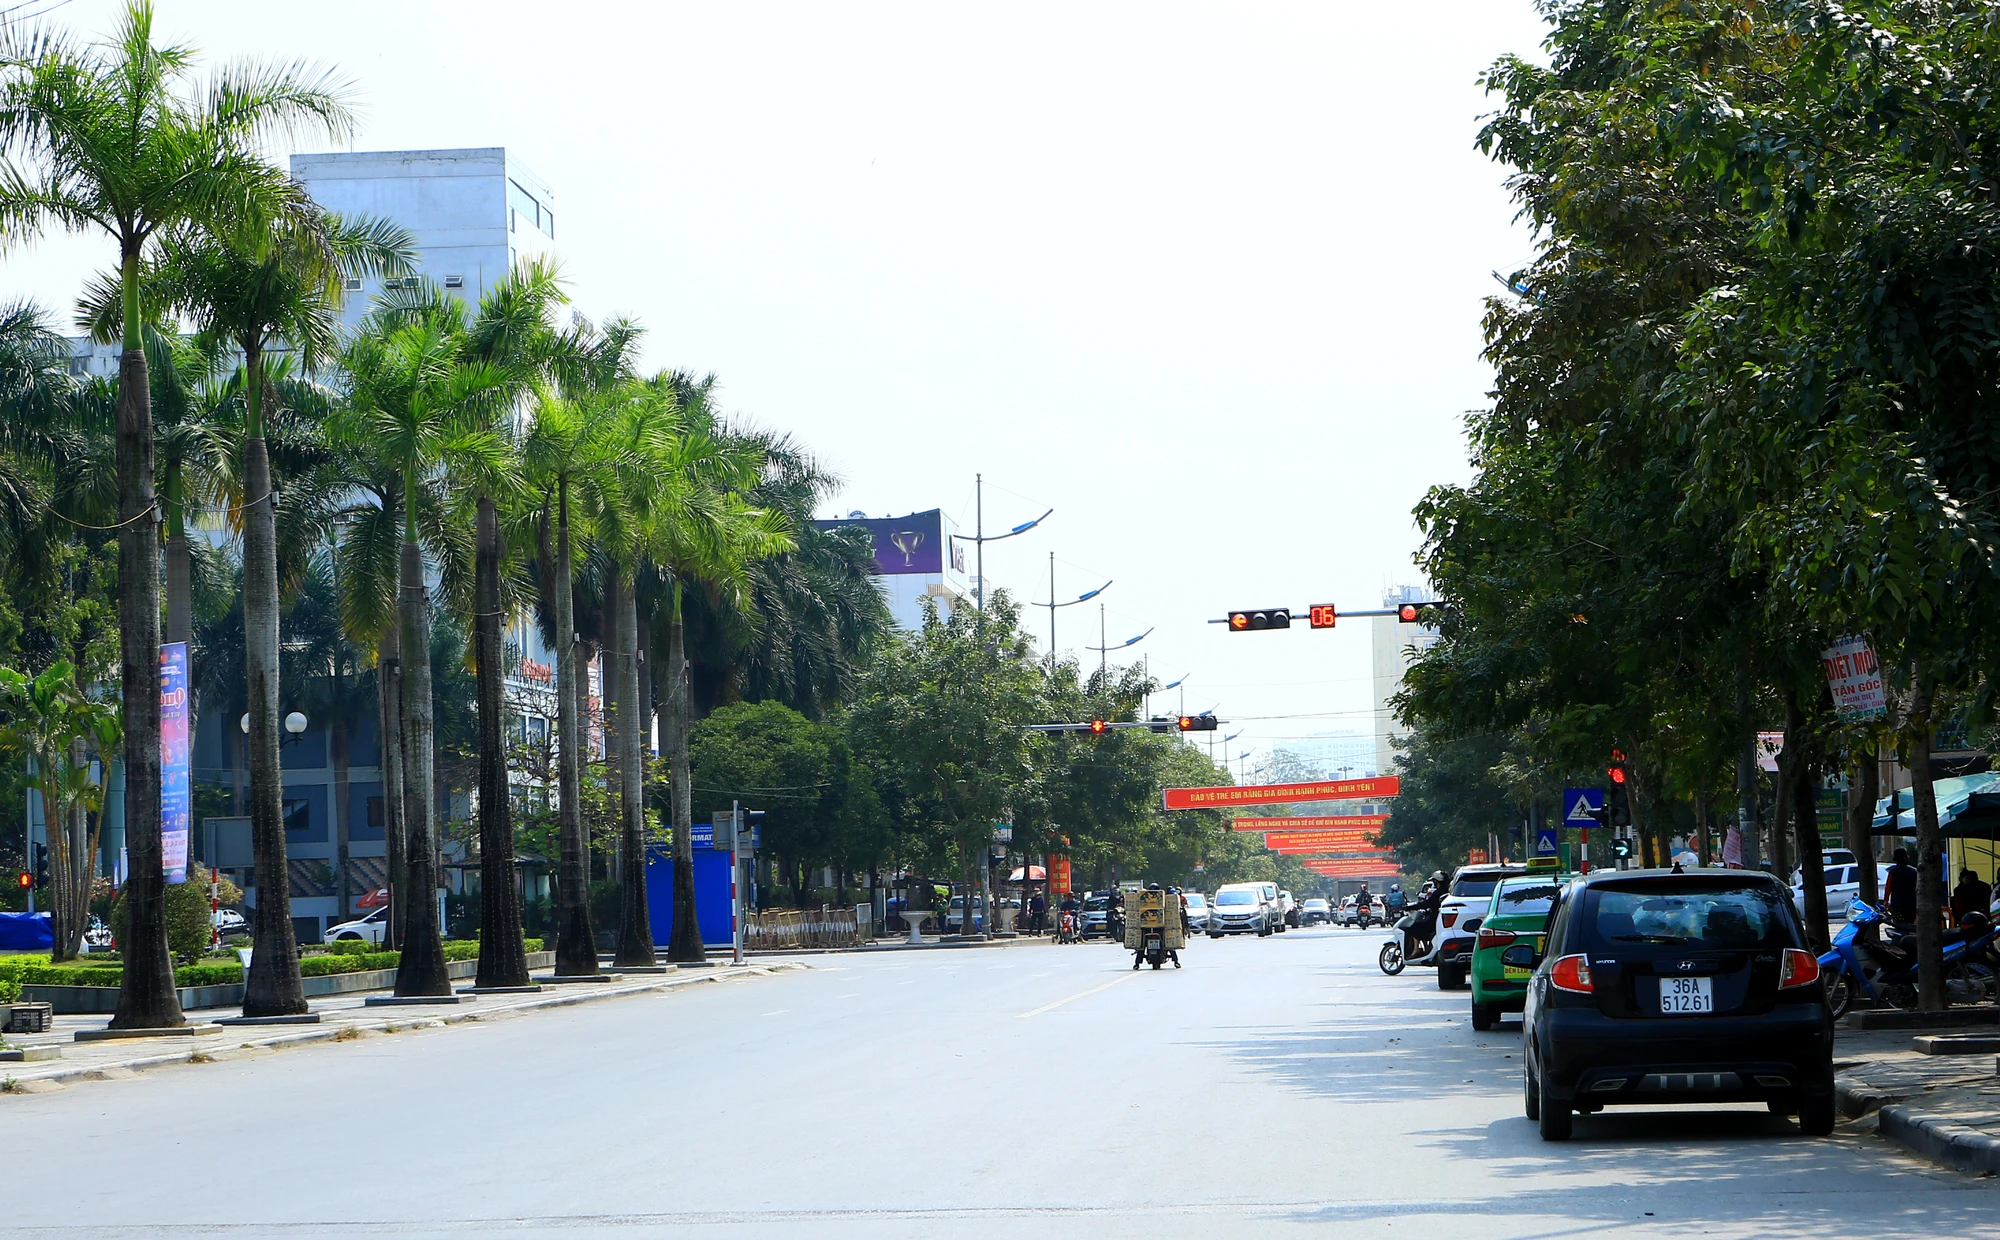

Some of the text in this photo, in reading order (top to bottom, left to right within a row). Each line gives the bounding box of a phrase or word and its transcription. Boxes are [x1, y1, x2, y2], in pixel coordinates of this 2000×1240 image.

[1311, 606, 1334, 626] 06
[1824, 651, 1852, 683] DIỆT
[1833, 678, 1880, 698] TẬN GỐC
[1190, 792, 1205, 802] BẢO
[1206, 792, 1215, 801] VỆ
[1216, 790, 1229, 800] TRẺ
[1231, 791, 1242, 799] EM
[1264, 789, 1276, 797] GIA
[1277, 787, 1294, 797] ĐÌNH
[1295, 786, 1315, 797] HẠNH
[1338, 784, 1356, 793] BÌNH
[1357, 782, 1371, 792] YÊN
[1672, 978, 1700, 994] 36A
[1662, 995, 1710, 1011] 512.61
